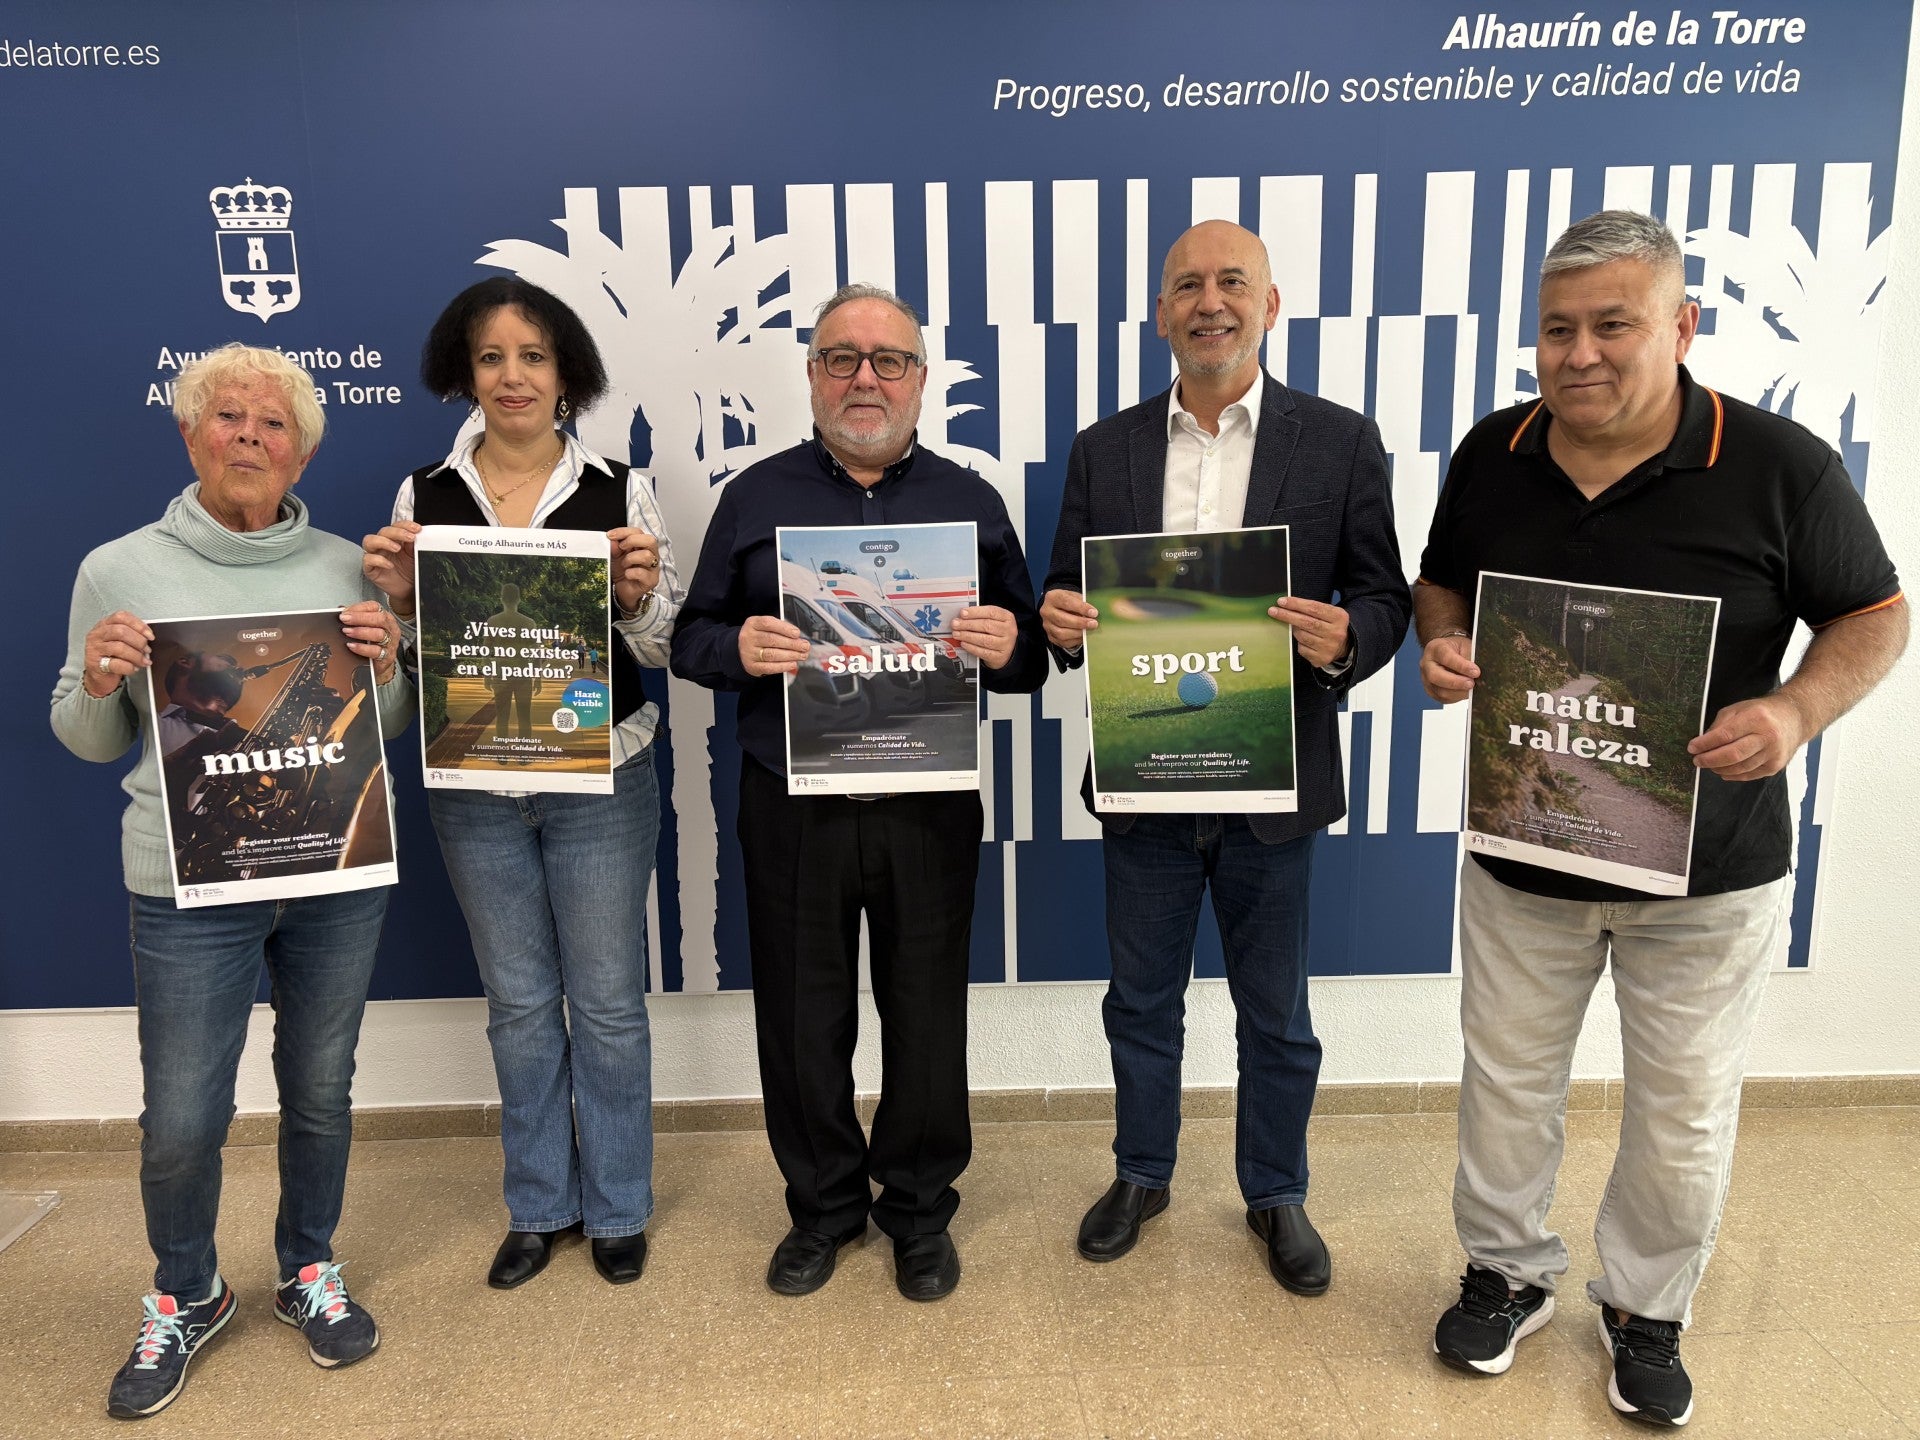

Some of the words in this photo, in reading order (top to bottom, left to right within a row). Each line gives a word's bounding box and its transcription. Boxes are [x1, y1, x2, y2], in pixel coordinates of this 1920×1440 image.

[1442, 12, 1601, 50] Alhaurín
[1611, 11, 1657, 46] de
[1666, 10, 1700, 45] la
[1711, 11, 1806, 45] Torre
[0, 39, 160, 67] delatorre.es
[993, 78, 1152, 117] Progreso,
[1163, 71, 1330, 108] desarrollo
[1339, 66, 1514, 103] sostenible
[1520, 73, 1544, 106] y
[1551, 62, 1676, 98] calidad
[1683, 61, 1724, 94] de
[1735, 60, 1801, 93] vida
[350, 344, 382, 369] de
[333, 381, 401, 404] Torre
[458, 538, 493, 547] Contigo
[547, 540, 567, 549] MÁS
[1165, 550, 1197, 559] together
[1573, 603, 1606, 614] contigo
[242, 630, 277, 640] together
[463, 621, 516, 640] ¿Vives
[520, 625, 564, 643] aquí,
[450, 644, 490, 659] pero
[494, 645, 516, 658] no
[520, 645, 580, 660] existes
[828, 643, 937, 674] salud
[457, 664, 478, 676] en
[482, 661, 497, 676] el
[501, 662, 574, 680] padrón?
[1131, 645, 1245, 684] sport
[574, 690, 601, 699] Hazte
[572, 699, 603, 708] visible
[1525, 690, 1637, 728] natu
[492, 736, 542, 744] Empadrónate
[861, 734, 907, 742] Empadrónate
[1508, 723, 1652, 768] raleza
[202, 736, 346, 776] music
[1202, 759, 1227, 767] Quality
[1228, 758, 1236, 766] of
[1546, 809, 1600, 826] Empadrónate
[1565, 821, 1593, 832] Calidad
[1594, 826, 1603, 834] de
[222, 848, 236, 856] and
[297, 840, 325, 849] Quality
[325, 838, 333, 847] of
[239, 839, 272, 847] Register
[273, 837, 292, 845] your
[293, 832, 329, 842] residency
